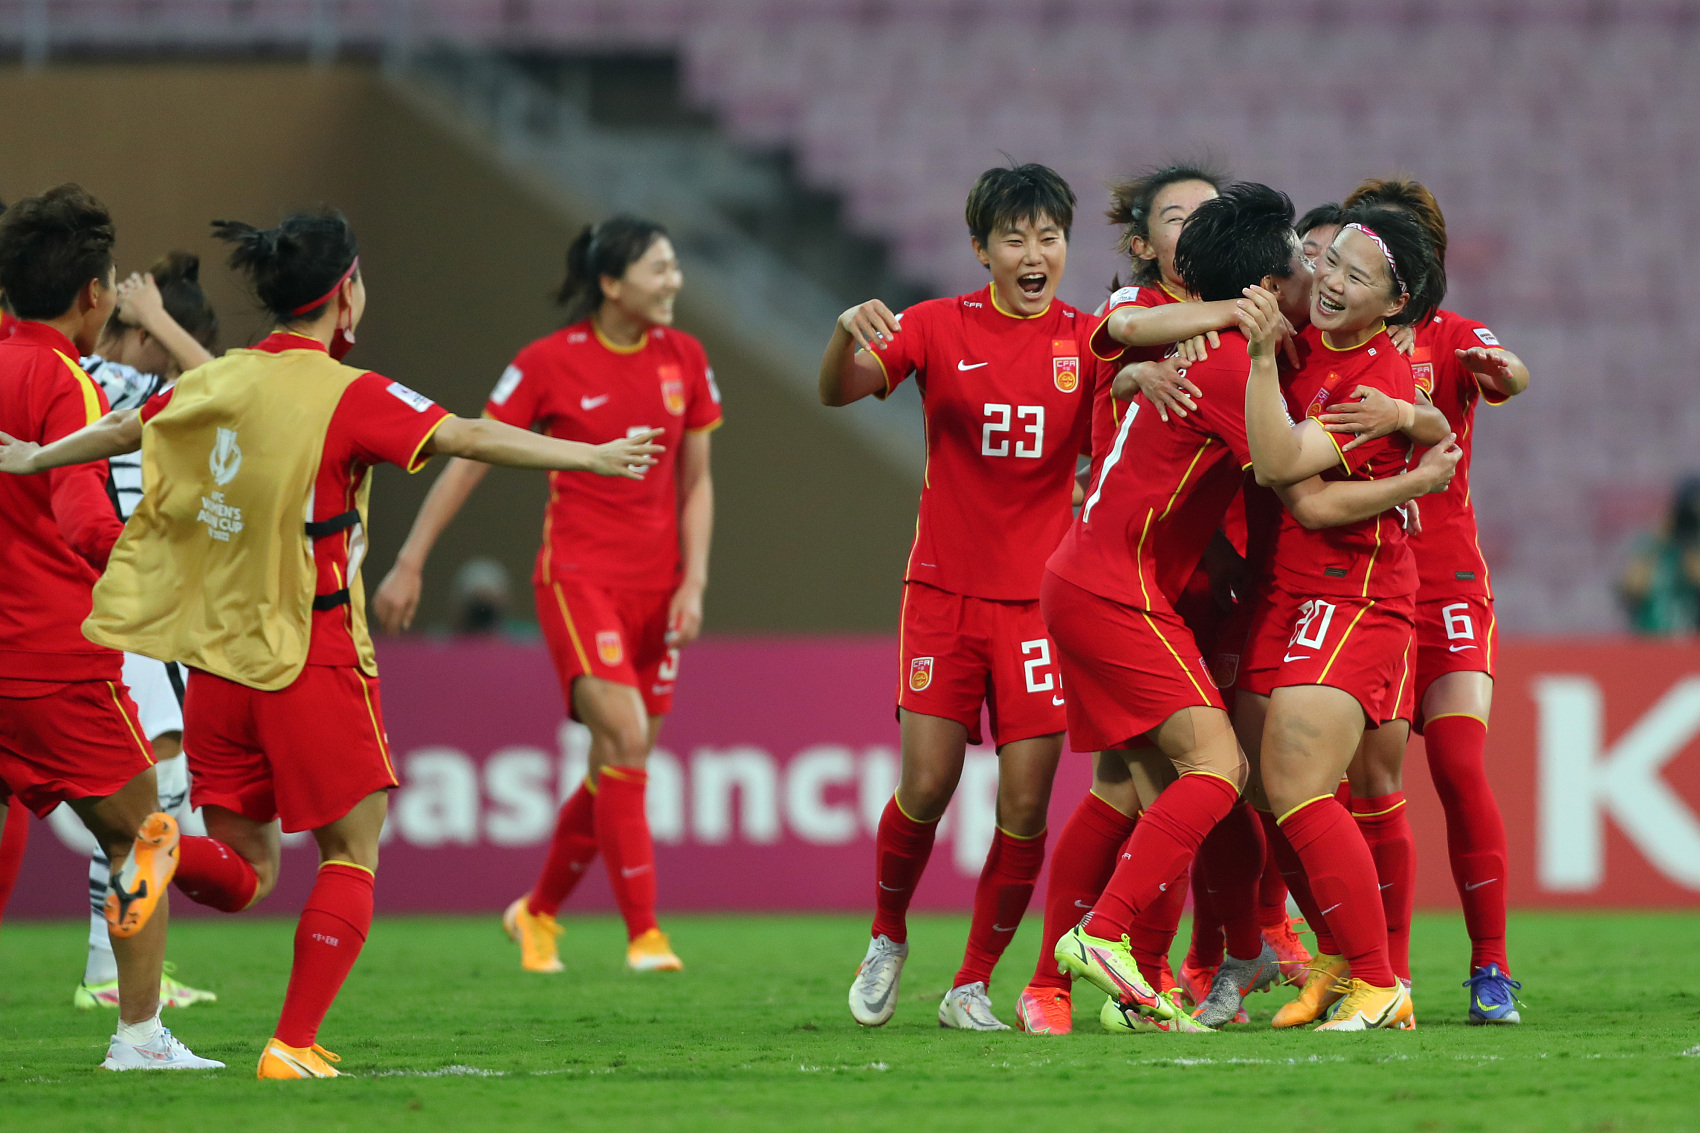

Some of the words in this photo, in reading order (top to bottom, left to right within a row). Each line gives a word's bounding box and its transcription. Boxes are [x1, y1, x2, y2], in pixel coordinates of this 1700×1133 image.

[981, 403, 1045, 459] 23
[1287, 600, 1337, 650] 20
[1442, 603, 1475, 640] 6
[913, 660, 931, 668] CFA
[1021, 638, 1063, 693] 2
